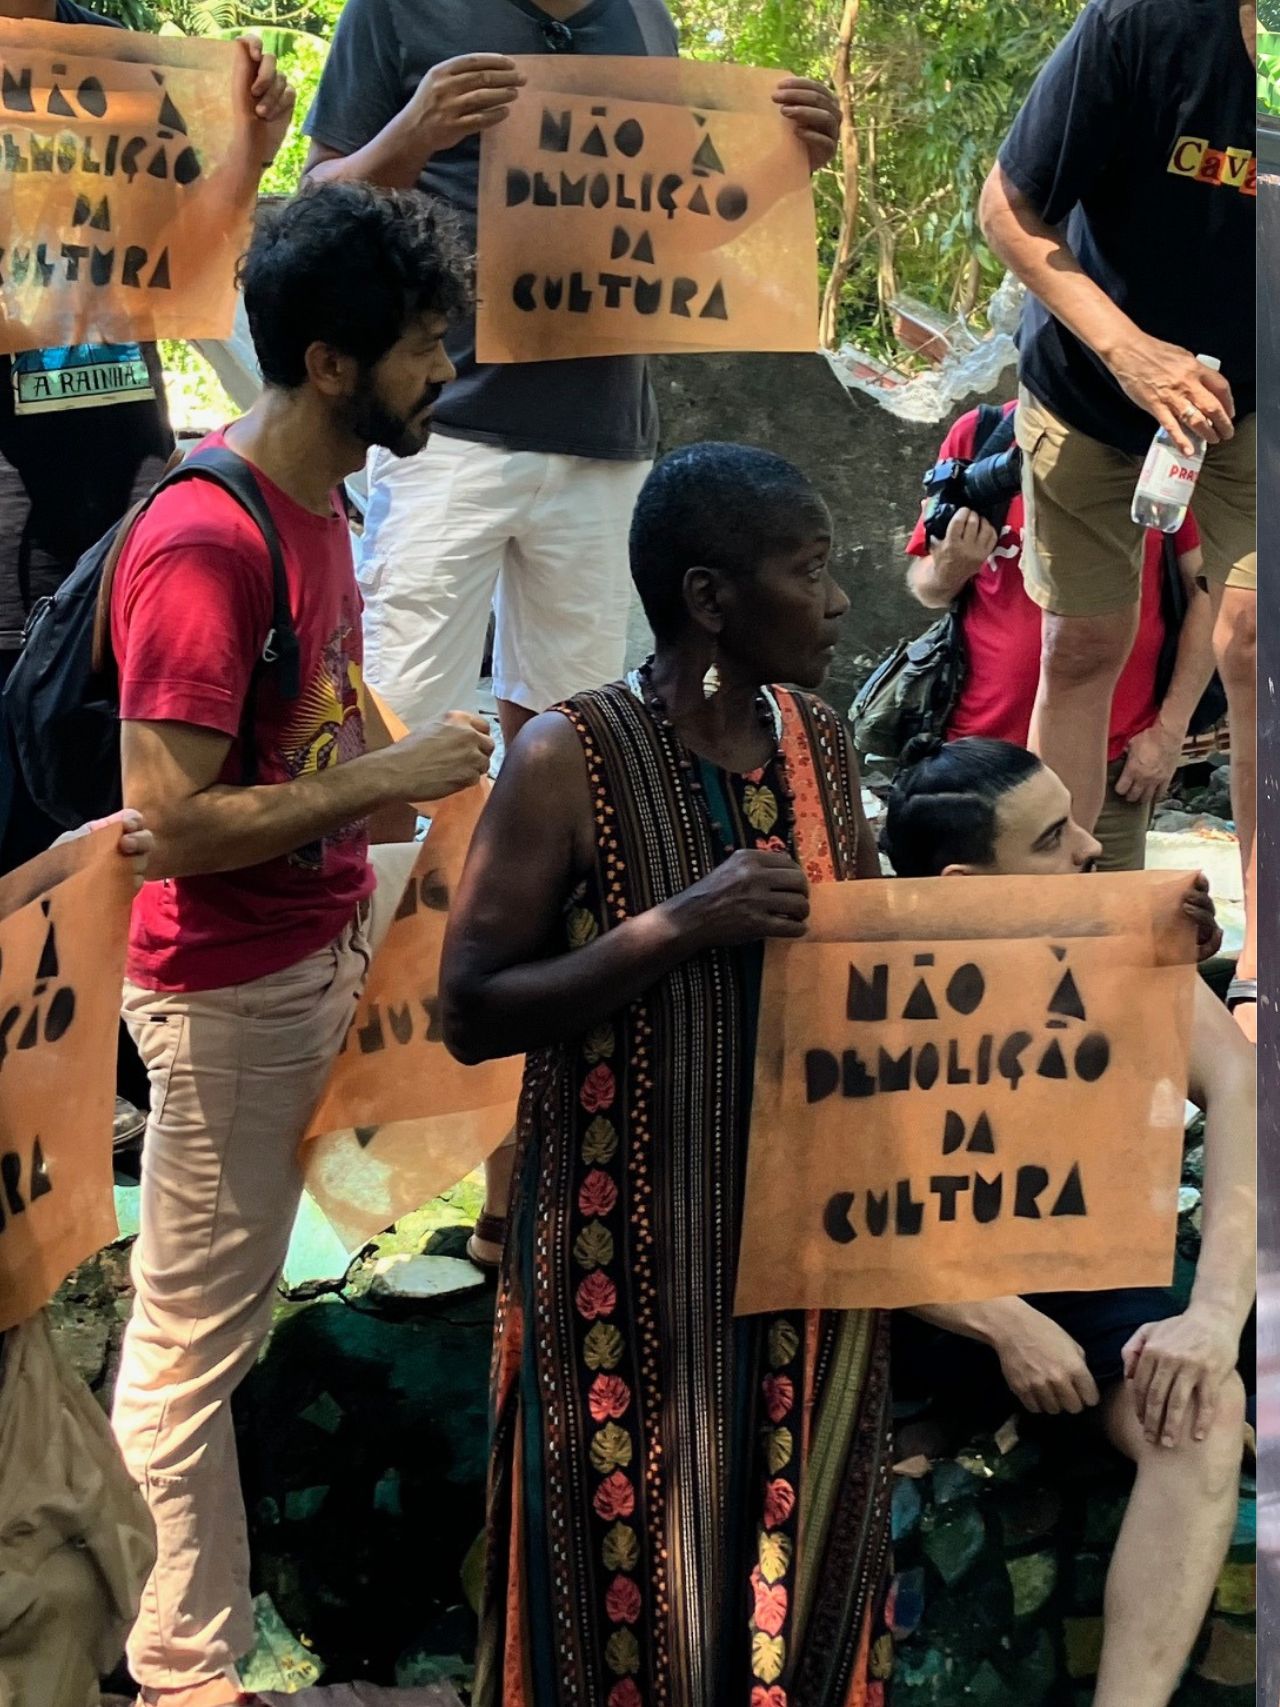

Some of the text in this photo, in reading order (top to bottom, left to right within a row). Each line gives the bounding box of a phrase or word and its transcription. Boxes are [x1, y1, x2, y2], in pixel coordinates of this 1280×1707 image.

[2, 63, 188, 136] NÃO À
[0, 130, 202, 186] EMOLIÇÃO
[538, 106, 725, 175] NÃO À
[72, 193, 111, 232] DA
[506, 165, 749, 222] DEMOLIÇÃO
[0, 243, 172, 290] ULTURA
[610, 225, 655, 264] DA
[512, 271, 729, 321] CULTURA
[33, 375, 55, 397] A
[846, 944, 1087, 1022] NÃO À
[805, 1018, 1111, 1105] DEMOLIÇÃO
[942, 1109, 996, 1156] DA
[823, 1161, 1088, 1245] CULTURA
